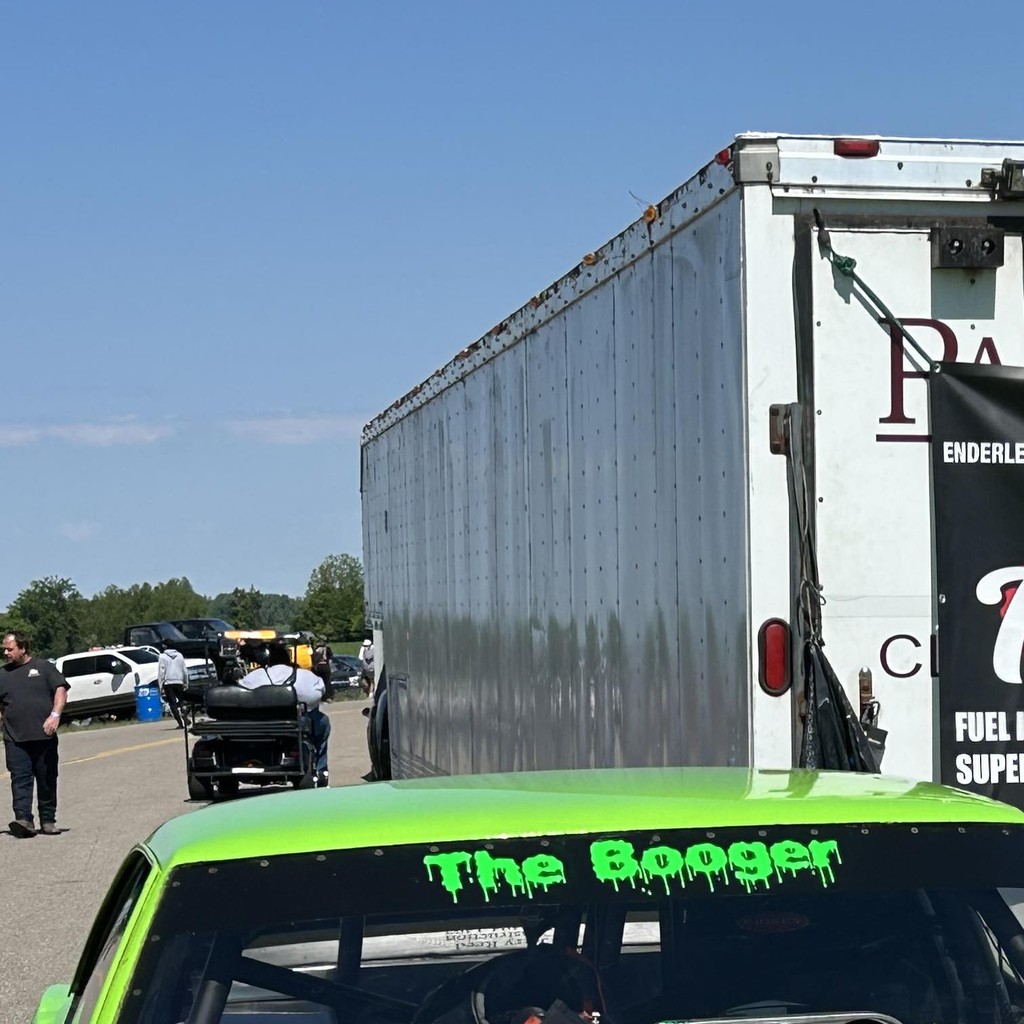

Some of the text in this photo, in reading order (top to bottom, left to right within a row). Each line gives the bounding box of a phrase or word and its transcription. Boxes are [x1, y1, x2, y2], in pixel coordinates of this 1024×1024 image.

[955, 711, 1011, 742] FUEL
[423, 839, 843, 904] The Booger
